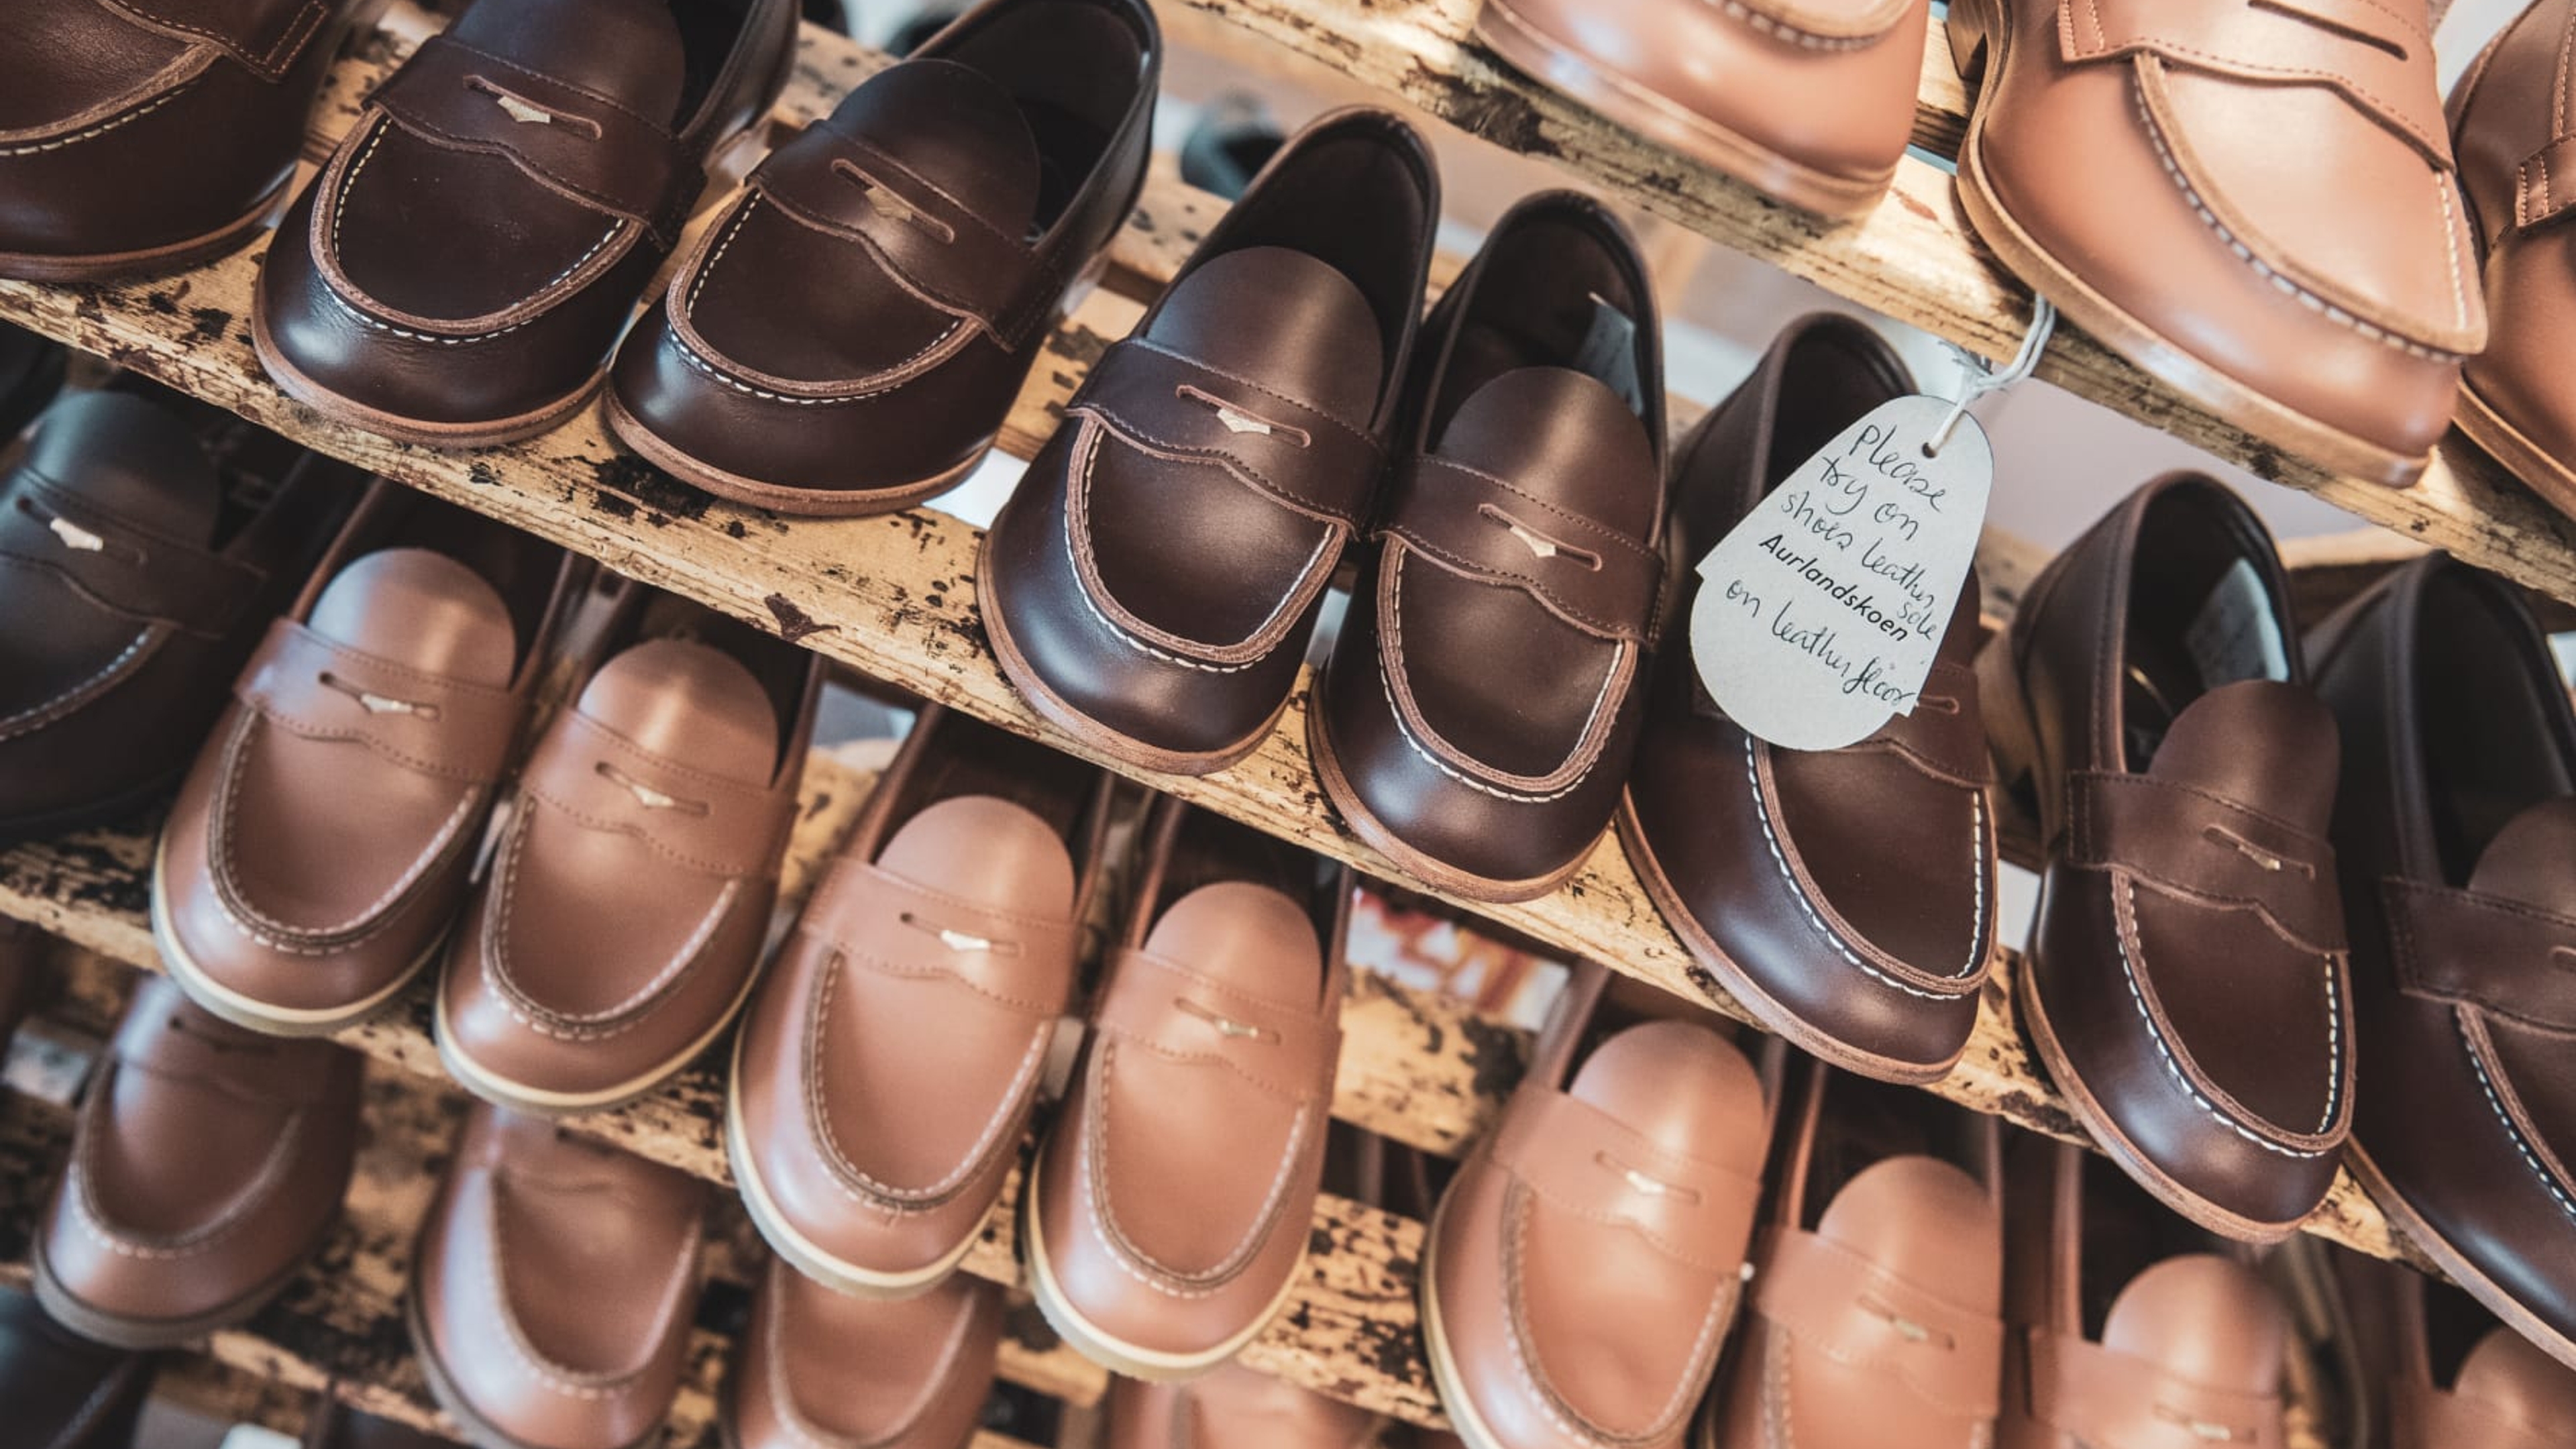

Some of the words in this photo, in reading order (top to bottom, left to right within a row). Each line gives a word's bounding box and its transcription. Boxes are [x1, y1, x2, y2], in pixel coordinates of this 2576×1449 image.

[1782, 491, 1853, 551] shoes
[1862, 538, 1934, 607] leather
[1821, 456, 1868, 515] try
[1874, 503, 1918, 540] on
[1727, 580, 1760, 618] on
[1772, 602, 1849, 677] leather
[1843, 657, 1917, 706] floor
[1759, 534, 1907, 641] Aurlandskoen
